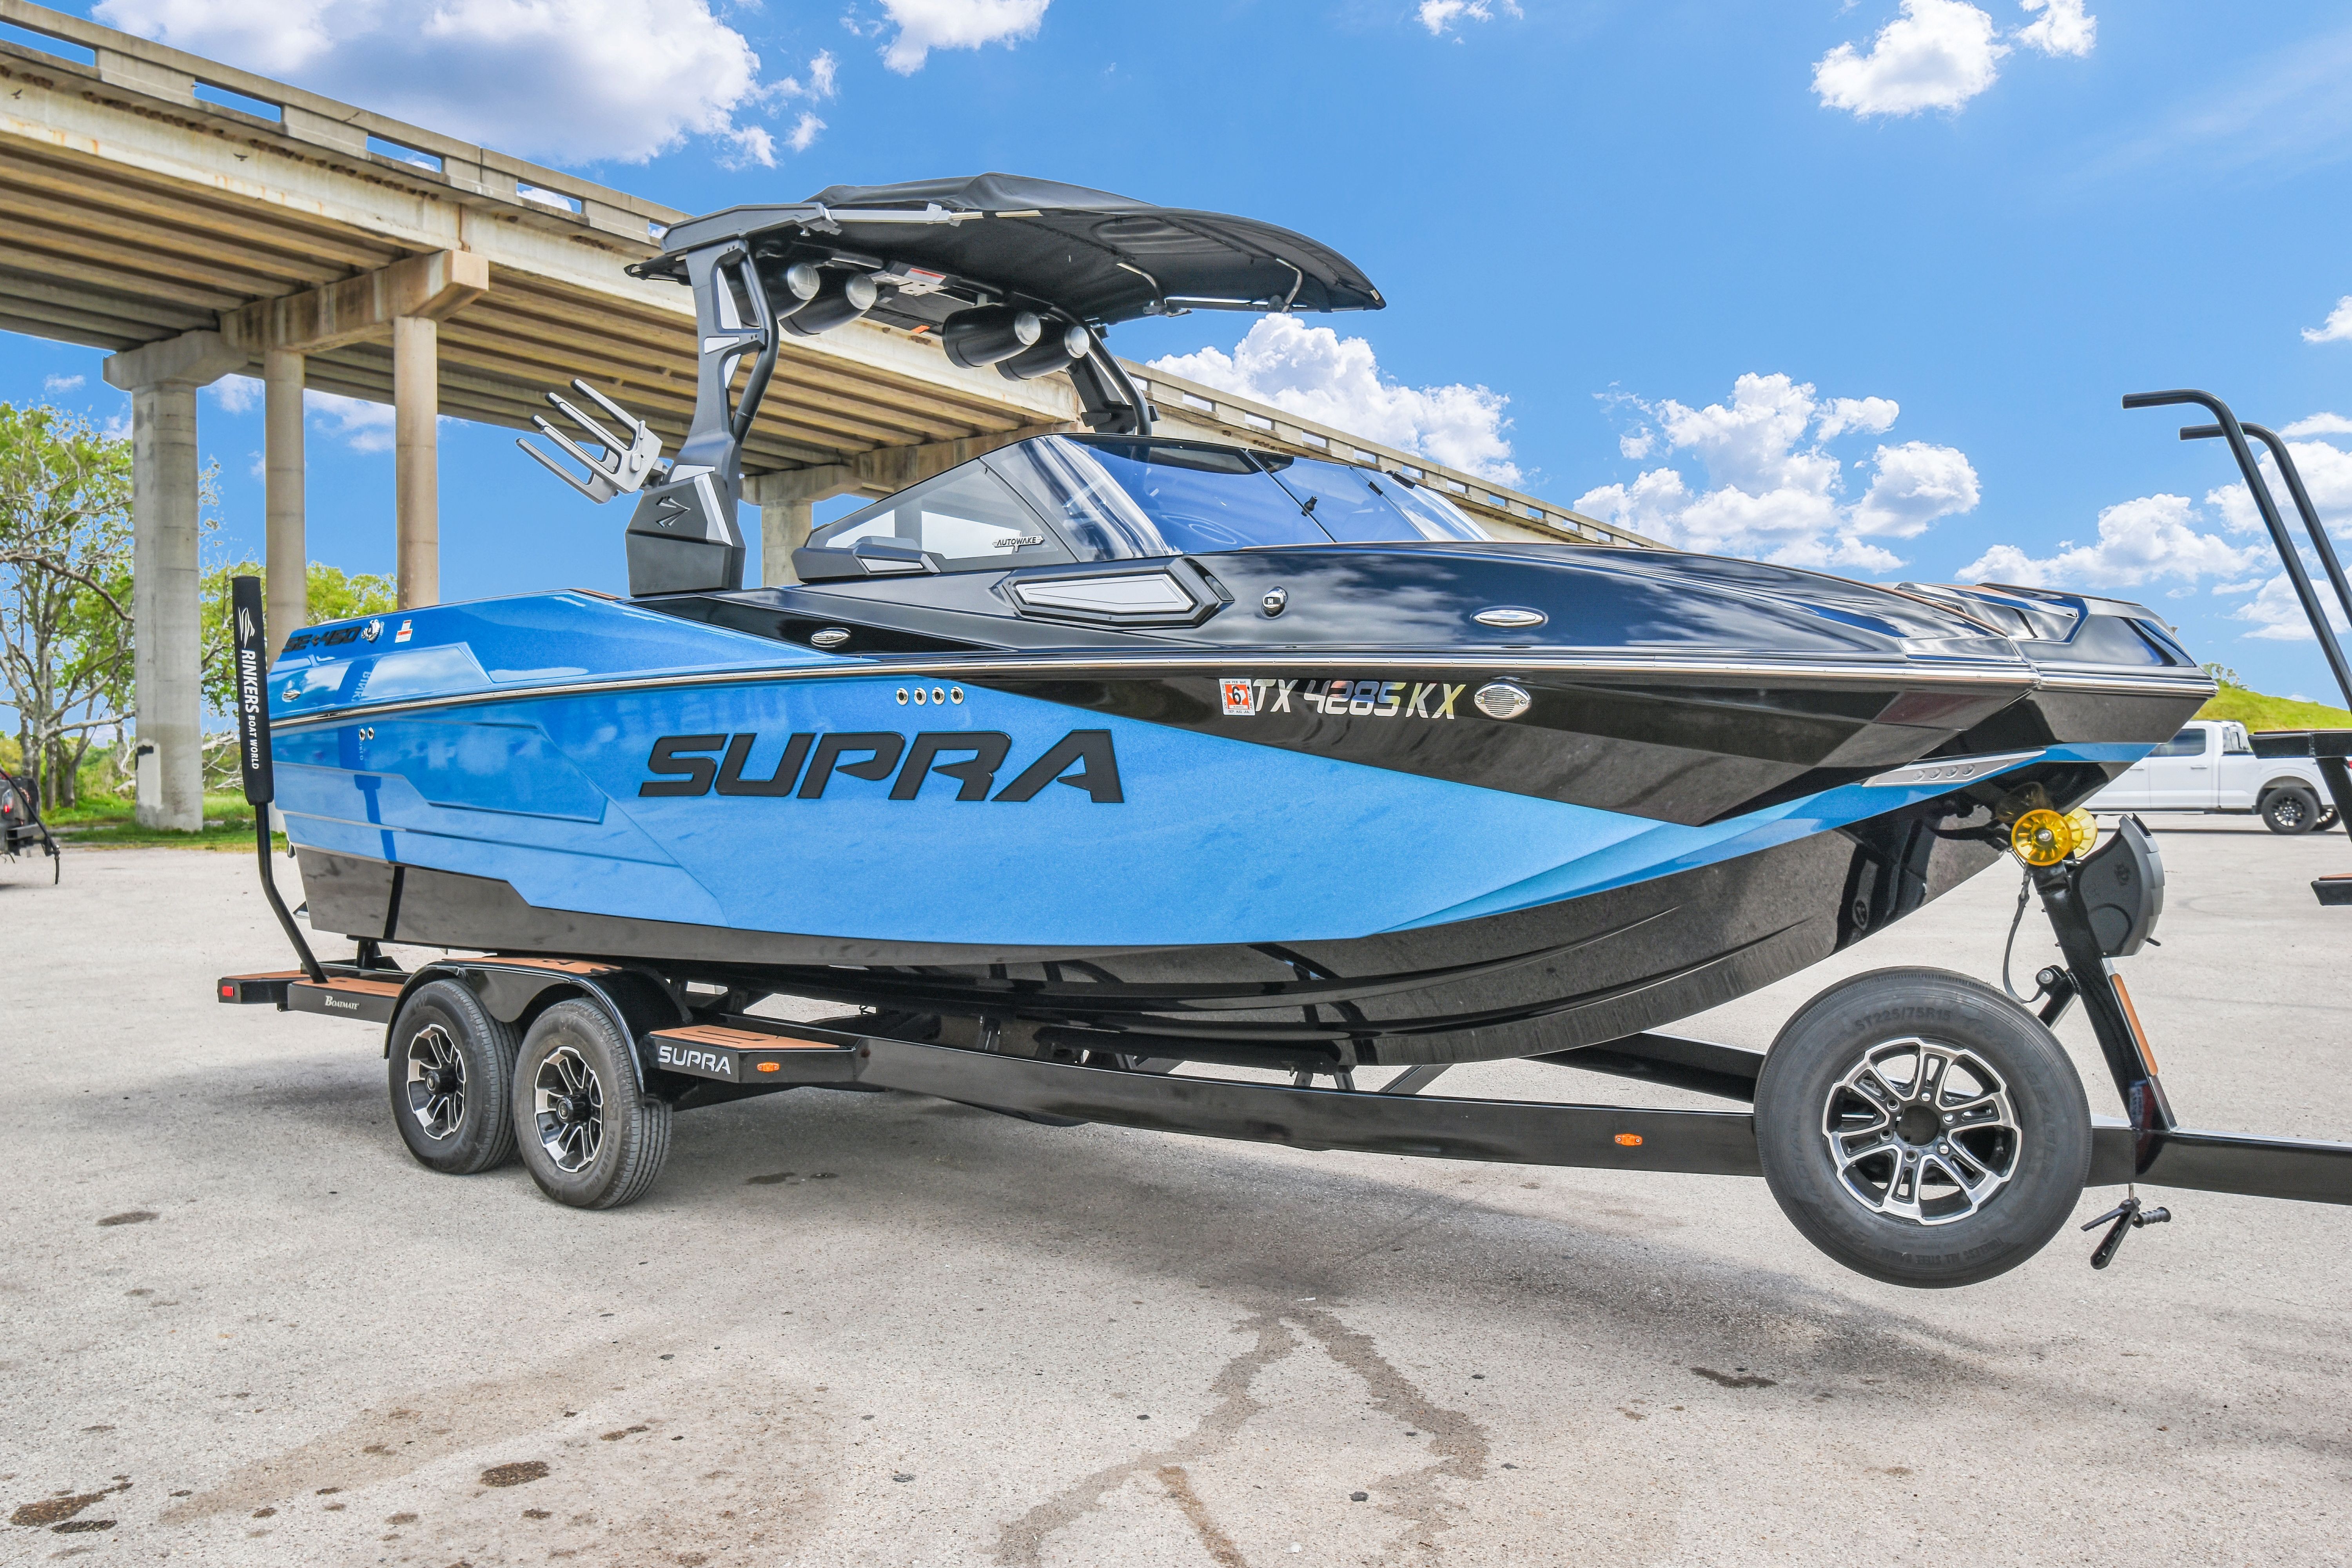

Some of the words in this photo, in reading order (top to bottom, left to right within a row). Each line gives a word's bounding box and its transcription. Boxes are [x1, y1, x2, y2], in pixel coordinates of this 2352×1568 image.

[997, 537, 1036, 546] AUTOWAKE
[241, 649, 259, 713] RINKERS
[1232, 686, 1241, 705] 6
[1253, 679, 1298, 713] TX
[1304, 680, 1406, 717] 4285
[1406, 682, 1466, 719] KX
[248, 715, 257, 737] BOAT
[250, 739, 259, 769] WORLD
[637, 729, 1125, 803] SUPRA
[1854, 1007, 1952, 1031] ST225/75R15
[657, 1045, 731, 1074] SUPRA
